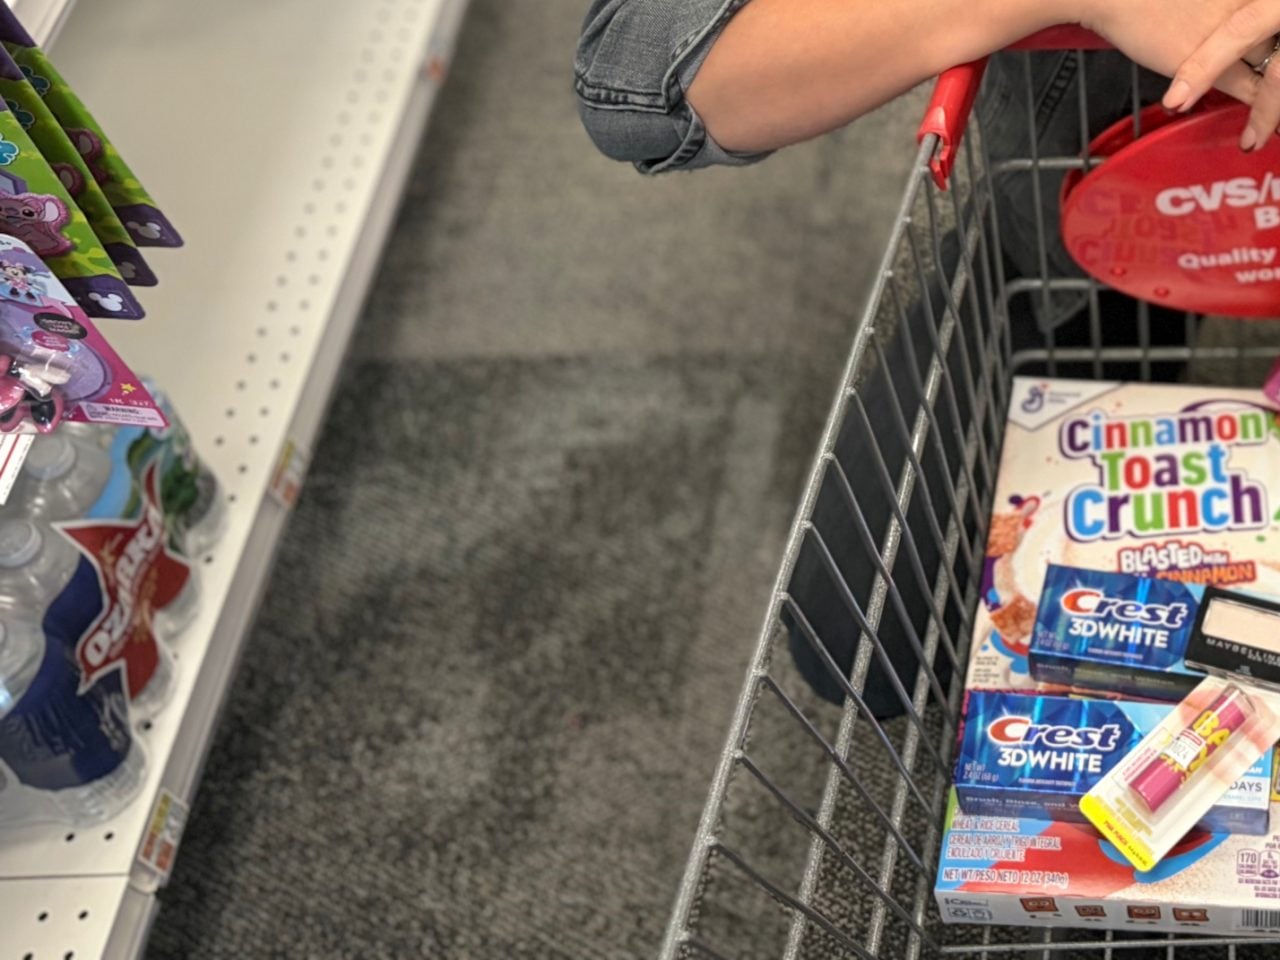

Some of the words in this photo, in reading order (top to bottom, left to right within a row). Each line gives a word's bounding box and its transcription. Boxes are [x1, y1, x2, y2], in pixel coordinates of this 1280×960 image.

[1177, 244, 1276, 270] Quality
[1066, 413, 1263, 452] Cinnamon
[1101, 443, 1228, 491] Toast
[1072, 474, 1263, 536] Crunch
[1120, 541, 1202, 573] BLASTED
[1060, 587, 1189, 628] Crest
[987, 716, 1121, 750] Crest
[944, 869, 957, 880] NET
[1240, 852, 1257, 864] 170
